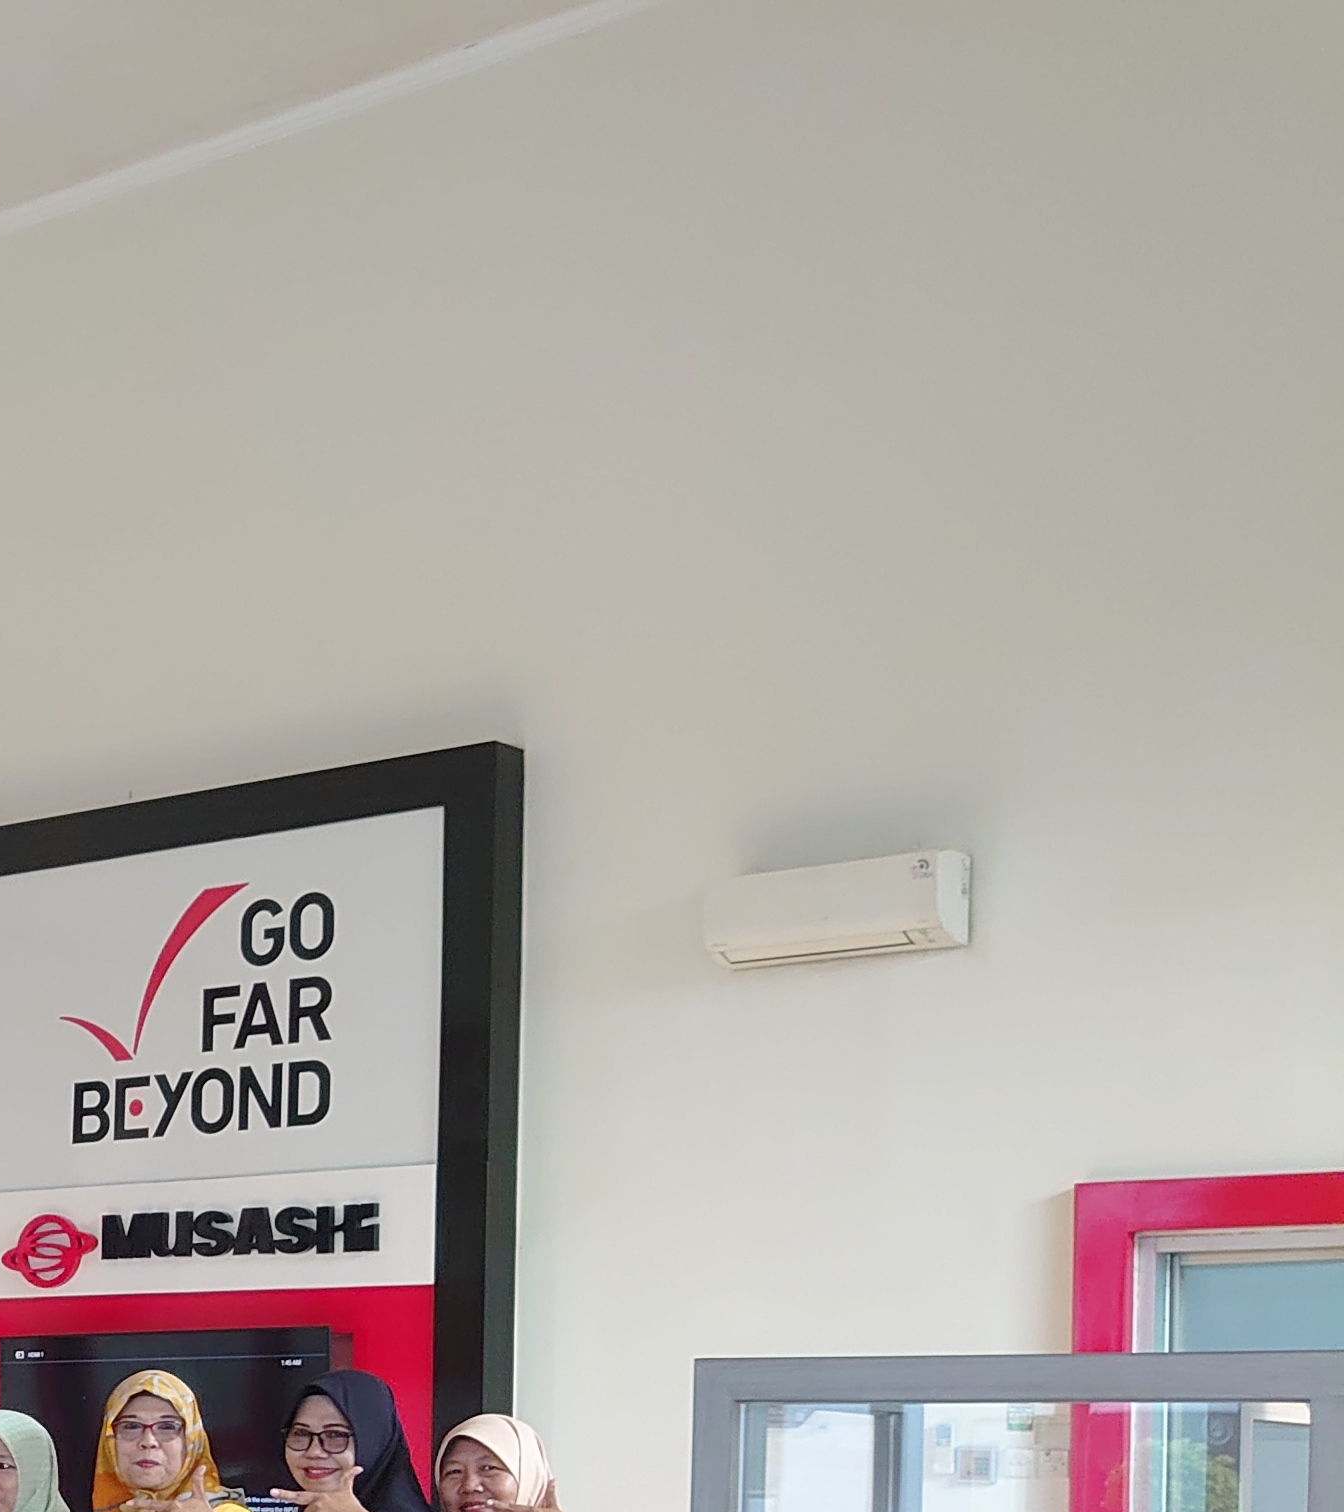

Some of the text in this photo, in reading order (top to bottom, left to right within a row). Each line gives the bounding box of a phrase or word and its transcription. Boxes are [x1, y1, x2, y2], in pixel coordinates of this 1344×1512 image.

[240, 892, 335, 966] GO
[201, 976, 332, 1052] FAR
[72, 1060, 331, 1144] BEYOND
[101, 1202, 380, 1260] MUSASHI
